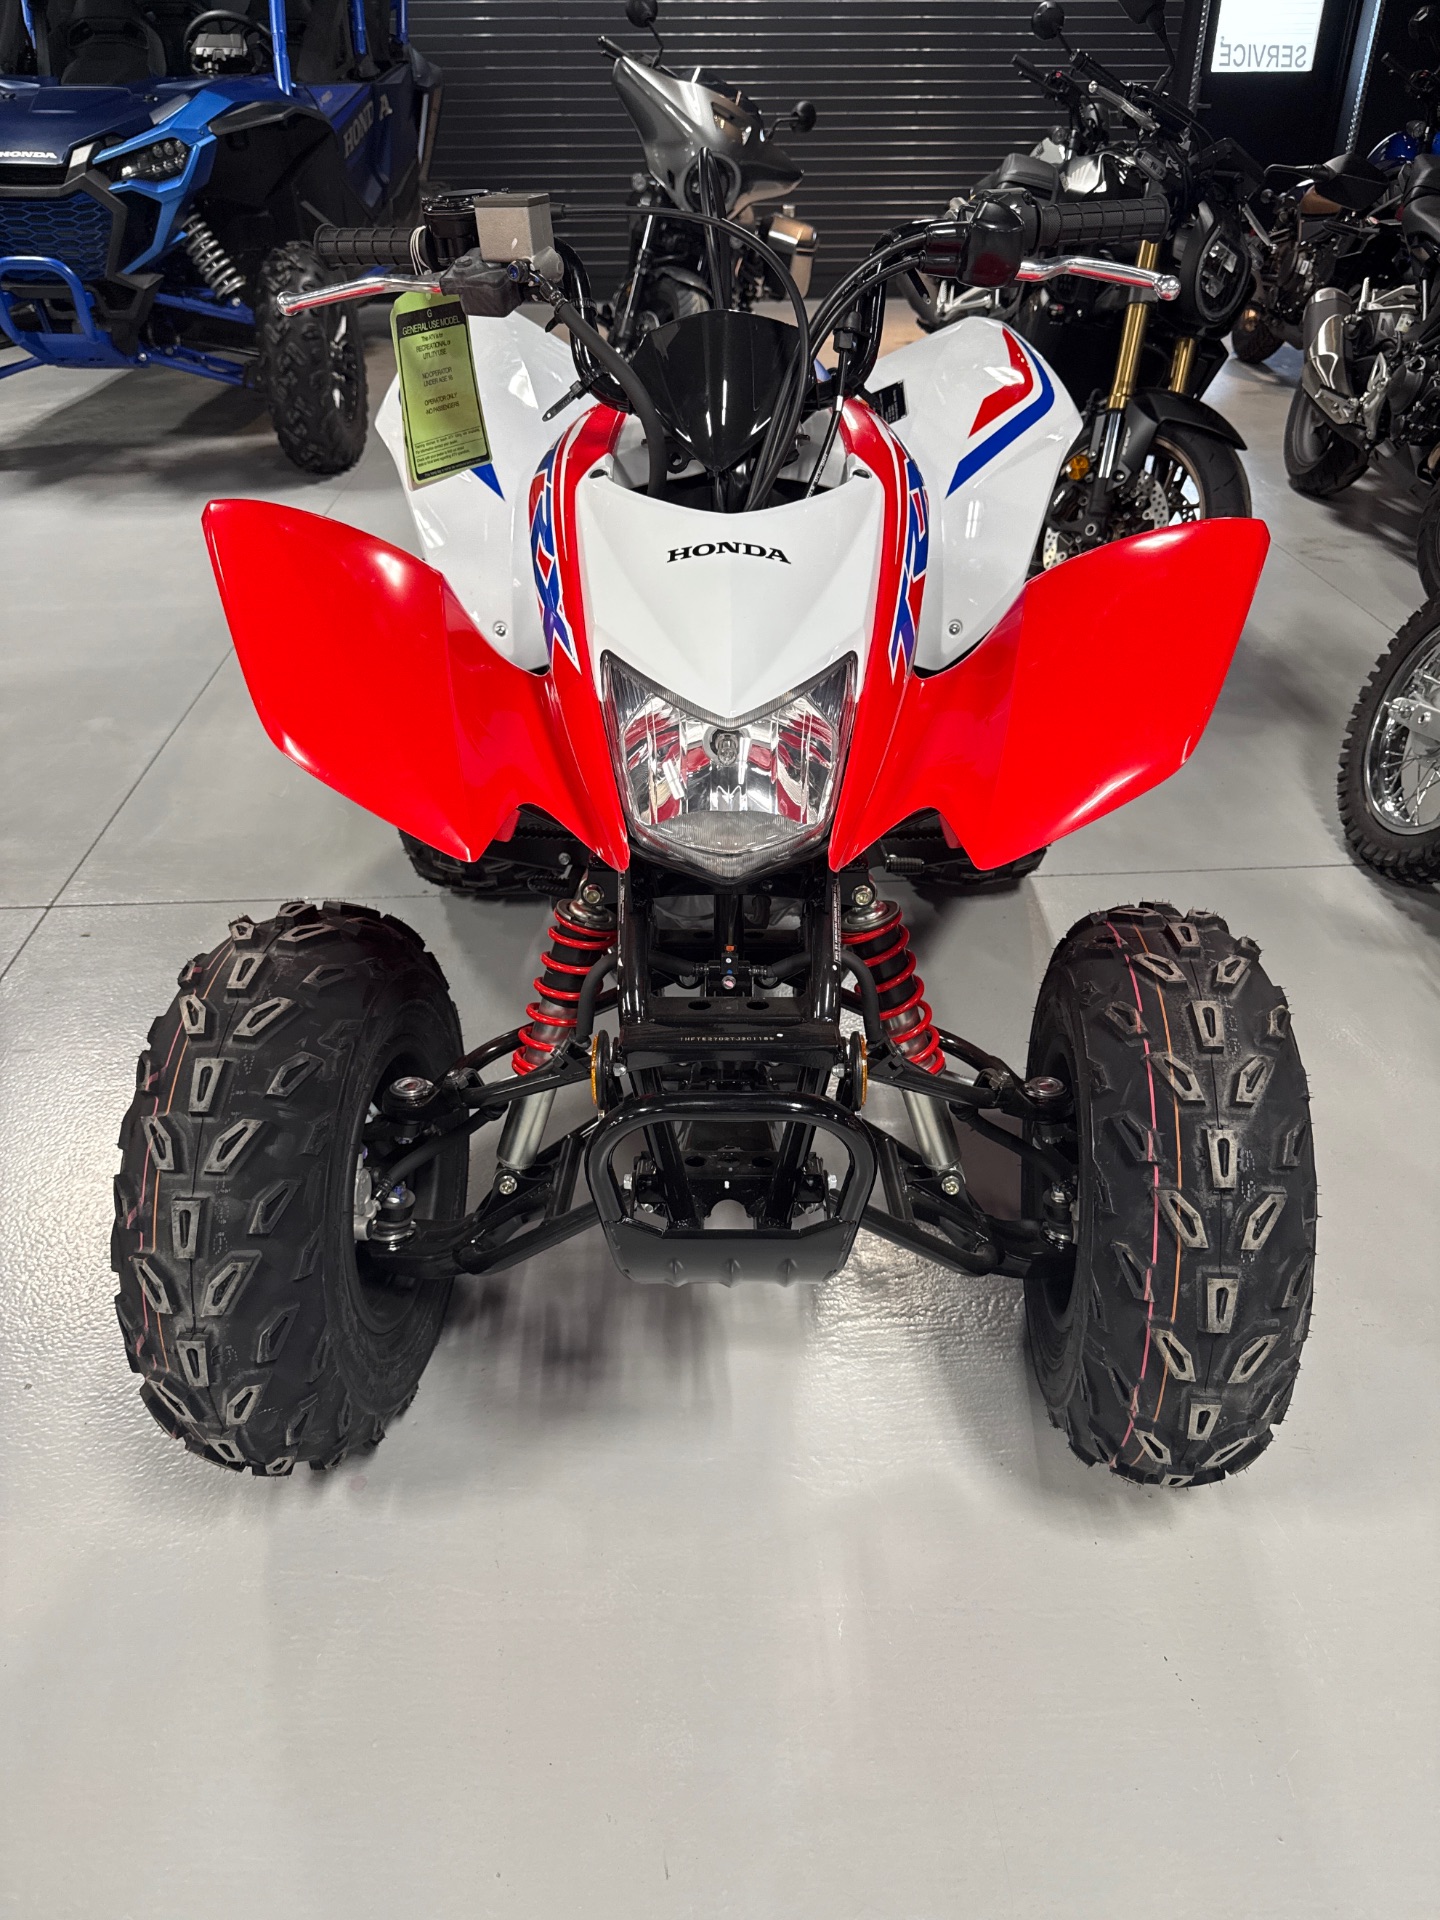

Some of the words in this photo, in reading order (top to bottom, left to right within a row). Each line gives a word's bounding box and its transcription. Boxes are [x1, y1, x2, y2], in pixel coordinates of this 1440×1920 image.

[0, 150, 57, 159] HONDA
[426, 308, 433, 318] G
[402, 322, 428, 336] GENERAL
[428, 319, 440, 330] USE
[440, 315, 461, 327] MODEL
[429, 366, 453, 378] OPERATOR
[666, 541, 792, 565] HONDA
